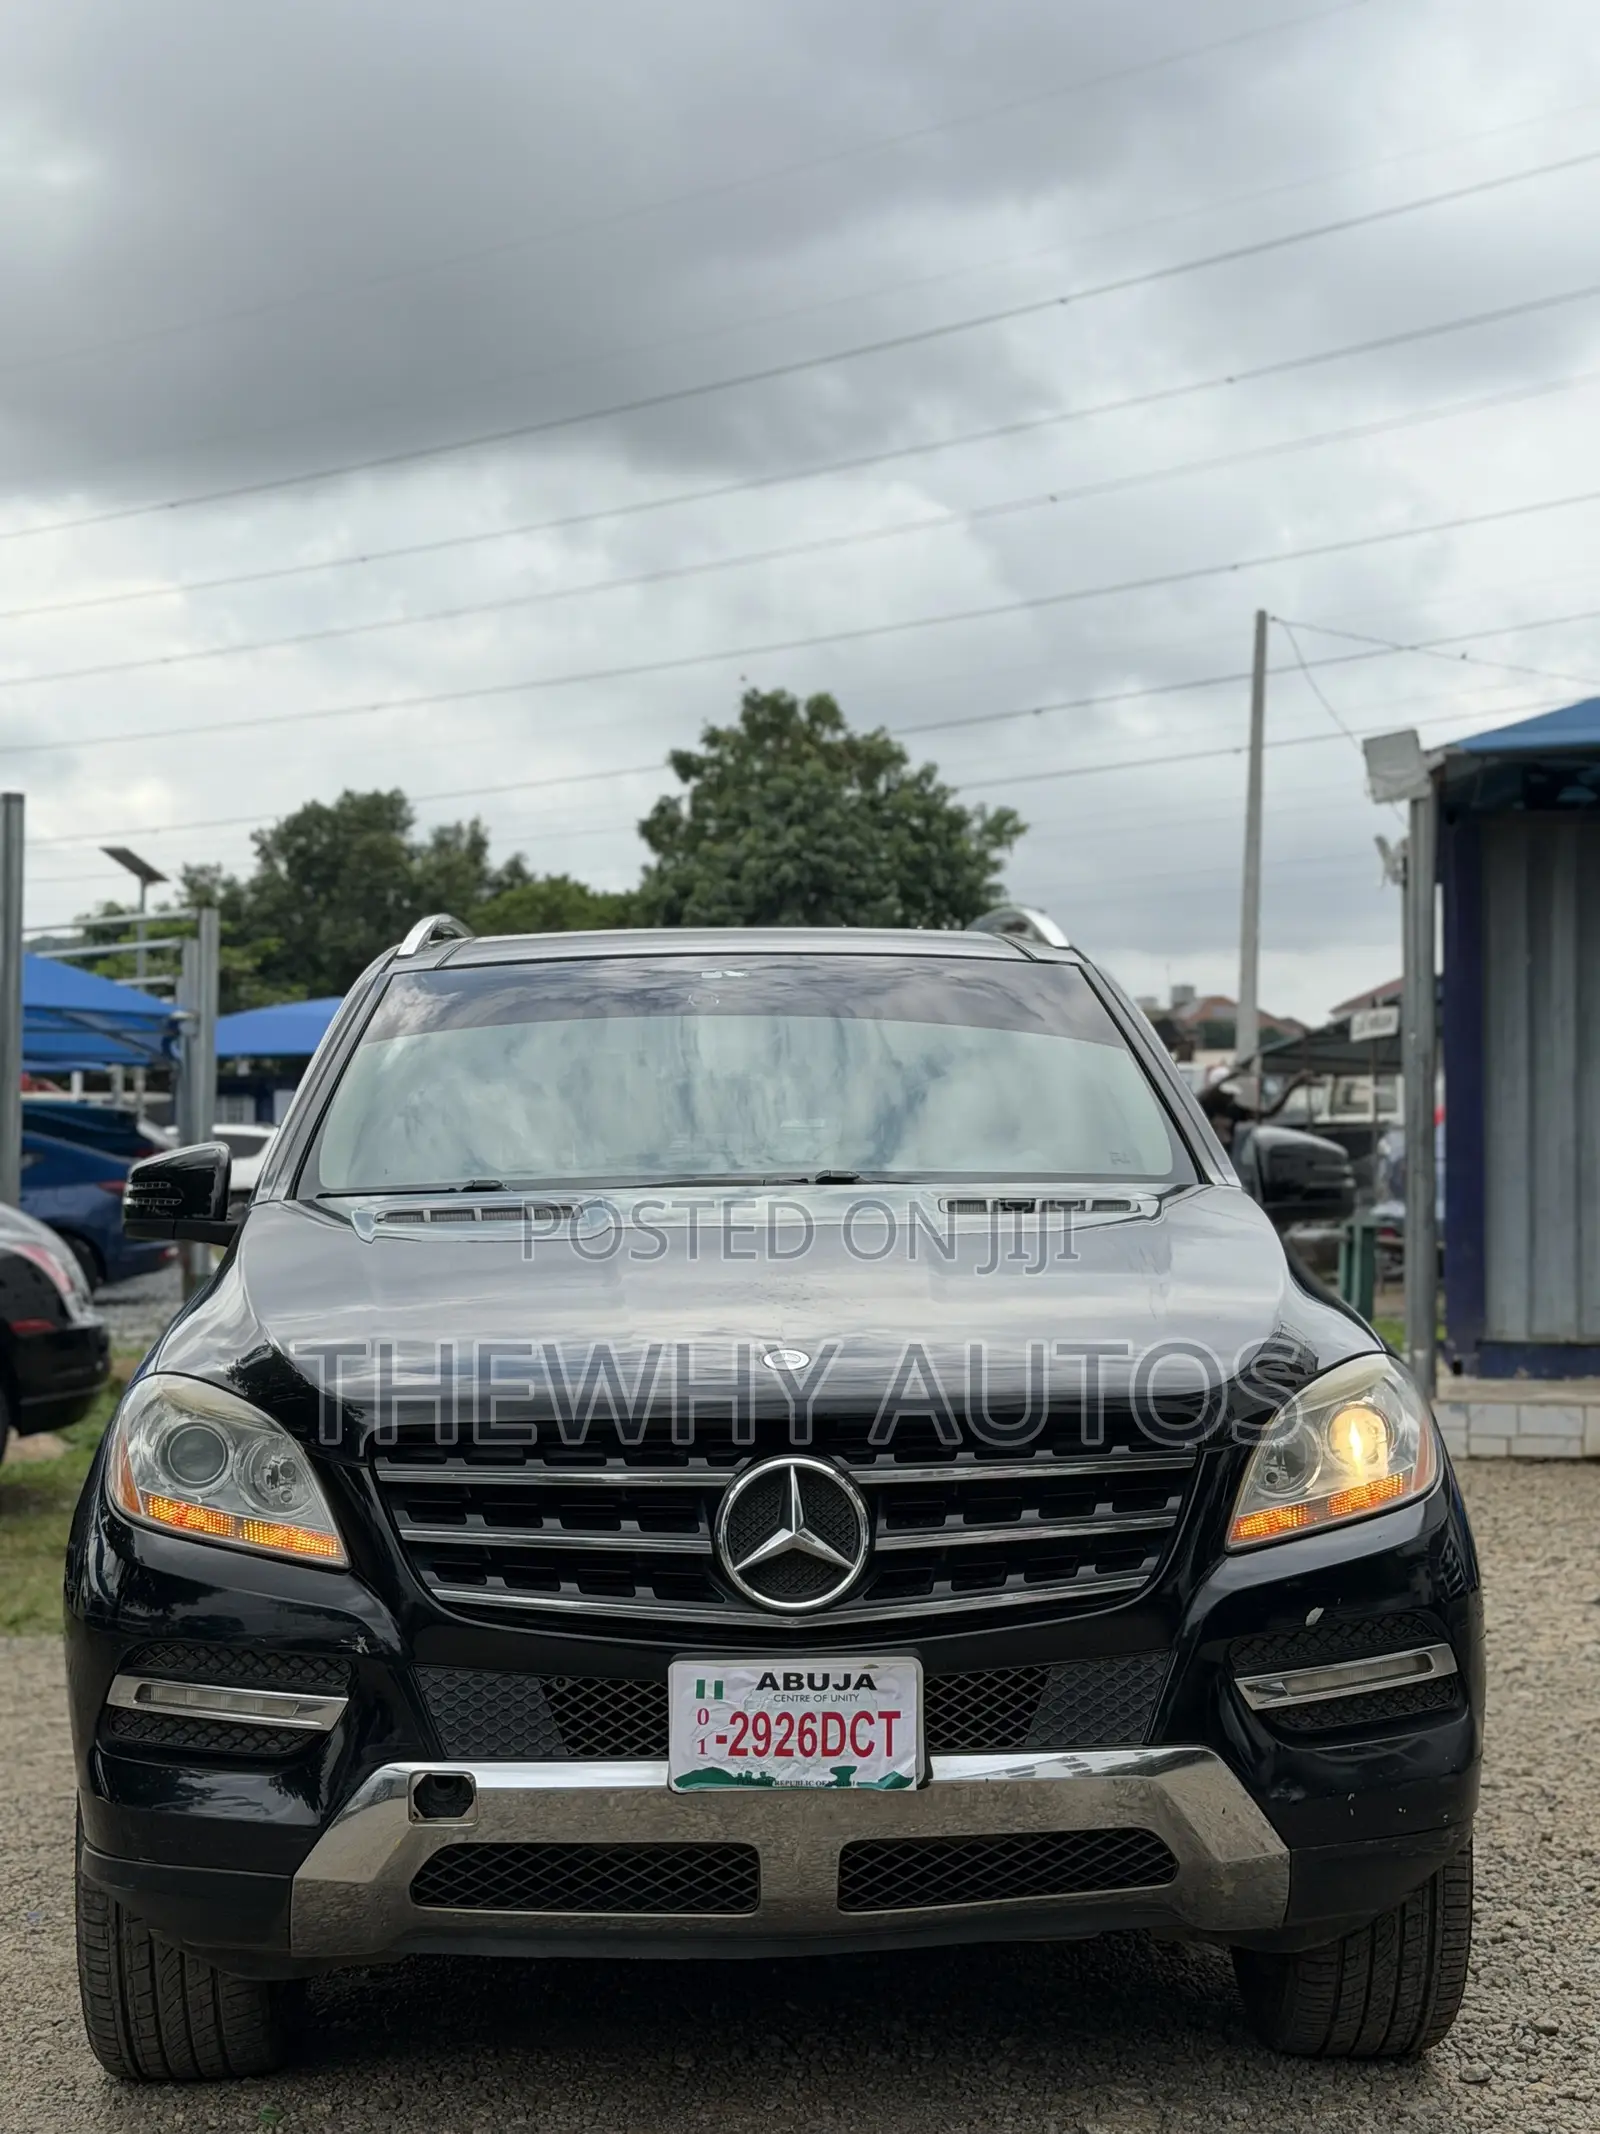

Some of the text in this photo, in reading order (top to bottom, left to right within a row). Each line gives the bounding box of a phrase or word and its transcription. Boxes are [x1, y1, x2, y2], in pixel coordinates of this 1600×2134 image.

[755, 1671, 878, 1691] ABUJA
[773, 1693, 860, 1703] CENTRE OF UNITY
[775, 1779, 815, 1787] REPUBLIC
